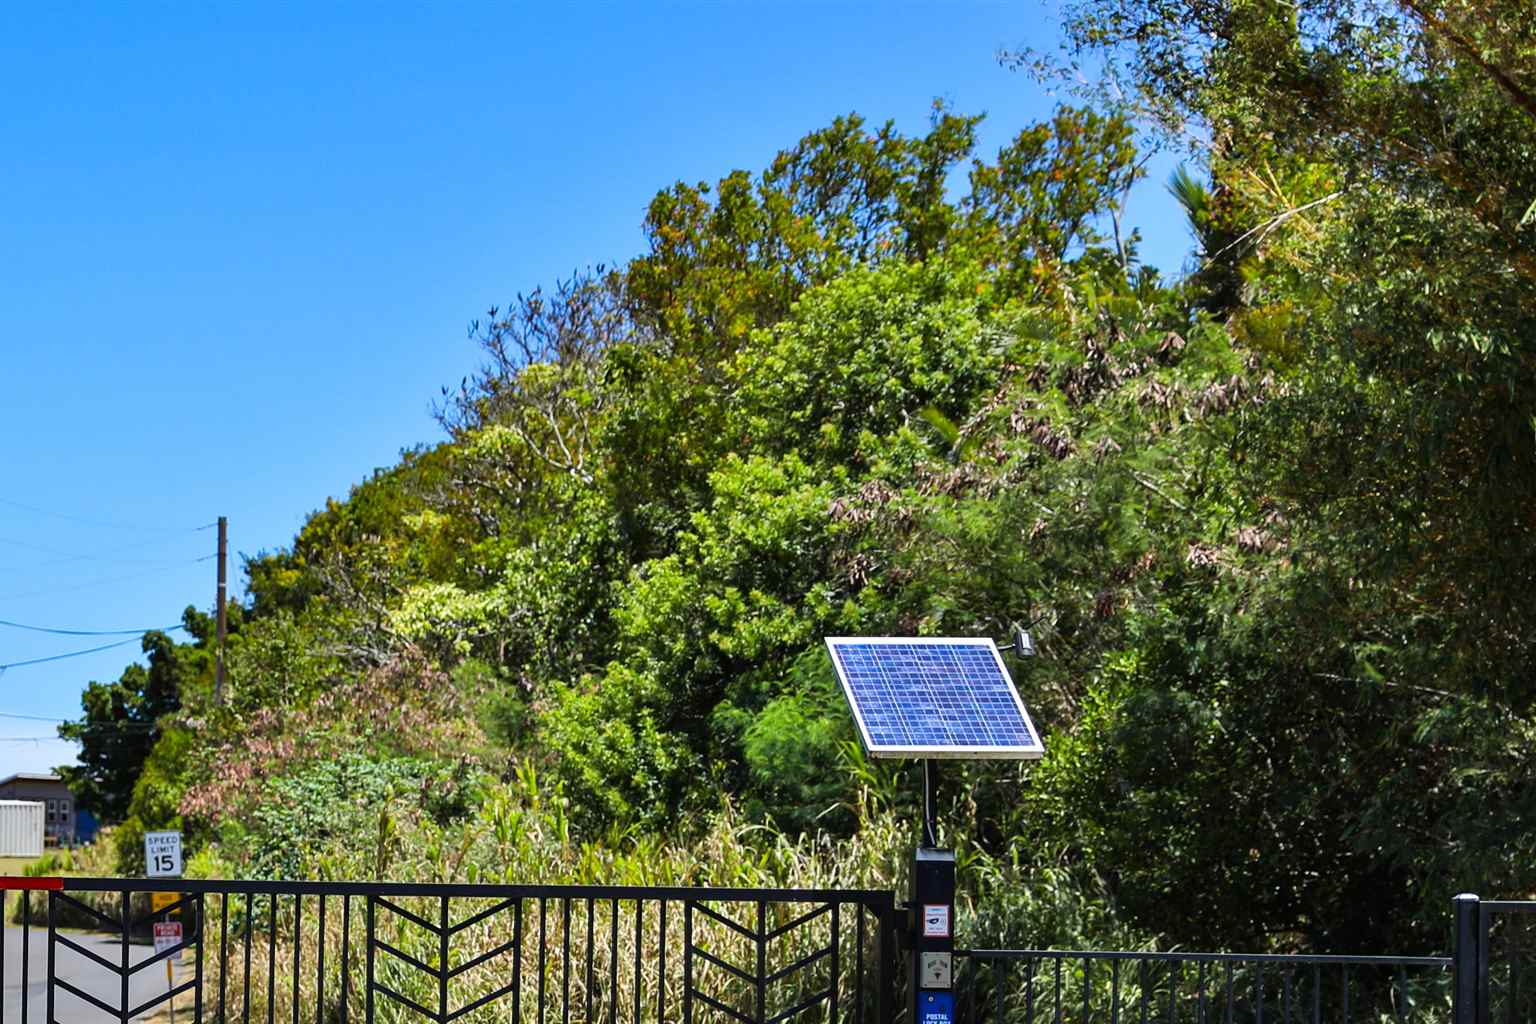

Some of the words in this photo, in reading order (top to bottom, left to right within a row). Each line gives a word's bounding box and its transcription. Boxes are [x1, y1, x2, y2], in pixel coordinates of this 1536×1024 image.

[149, 837, 177, 845] SPEED
[151, 846, 174, 854] LIMIT
[154, 855, 174, 871] 15
